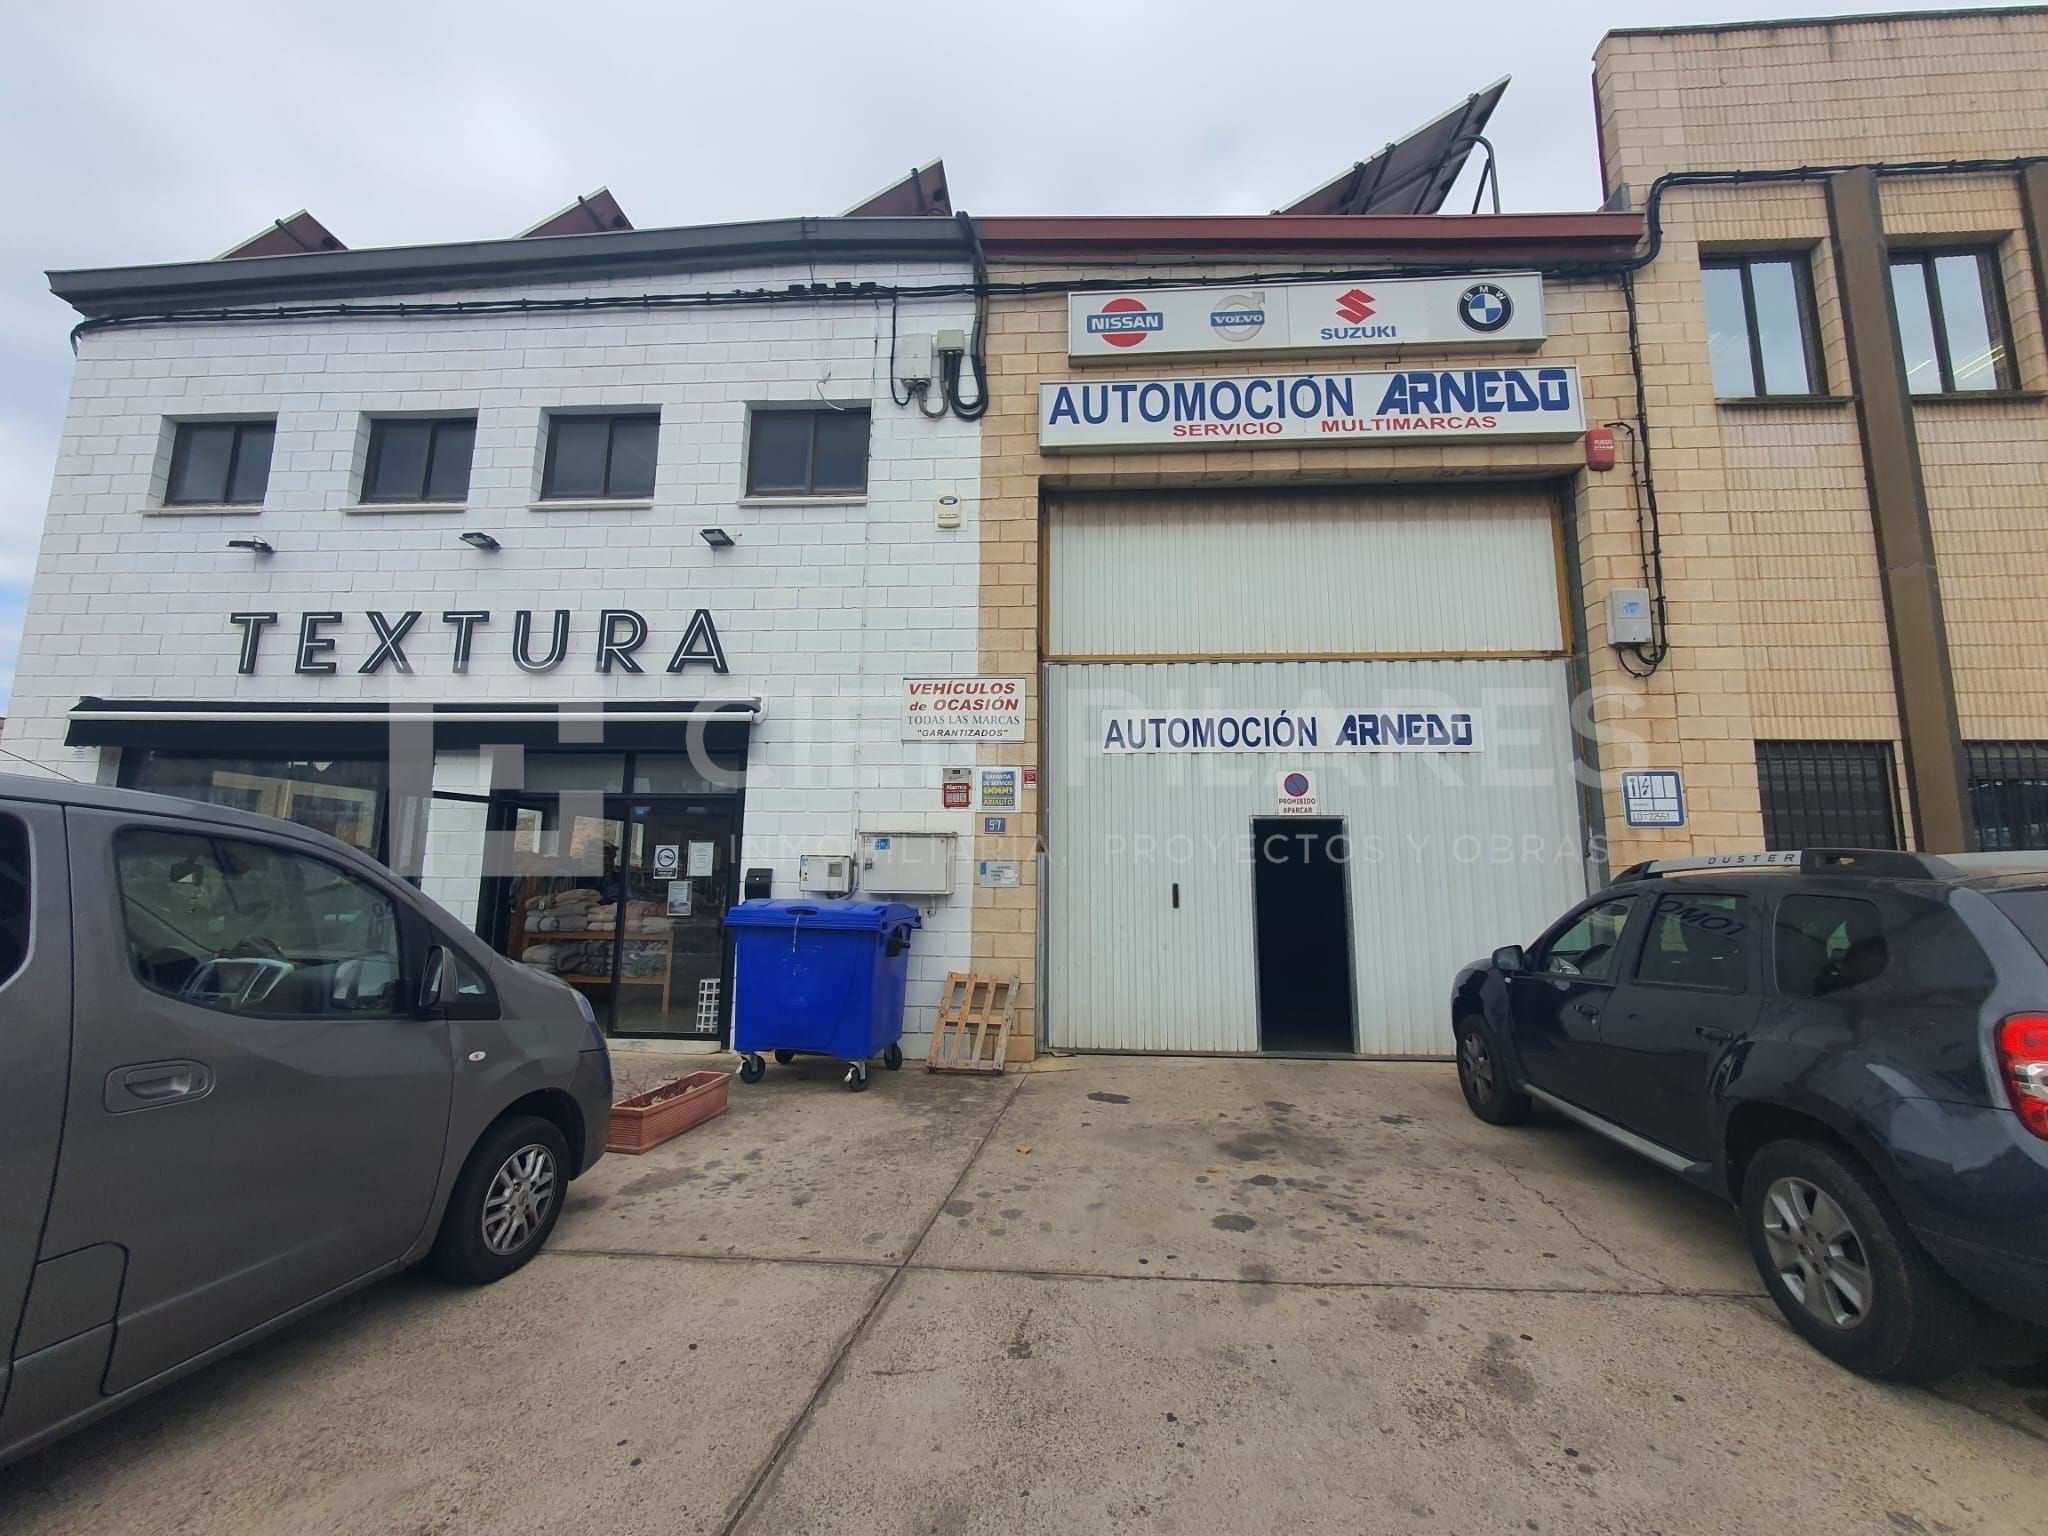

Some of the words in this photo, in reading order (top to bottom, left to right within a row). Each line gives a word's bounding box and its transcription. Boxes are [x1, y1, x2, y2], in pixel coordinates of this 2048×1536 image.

[1463, 285, 1507, 301] BMW
[1091, 315, 1159, 331] NISSAN
[1212, 314, 1264, 325] VOLVO
[1320, 325, 1397, 340] SUZUKI
[1048, 375, 1354, 425] AUTOMOCIÓN
[1375, 369, 1571, 415] ARNEDO
[1172, 421, 1284, 437] SERVICIO
[1320, 415, 1498, 433] MULTIMARCAS
[229, 608, 730, 675] TEXTURA
[909, 680, 1016, 695] VEHÍCULOS
[909, 701, 927, 711] de
[933, 696, 1020, 711] OCASIÓN
[907, 715, 946, 725] TODAS
[948, 715, 969, 725] LAS
[972, 714, 1021, 725] MARCAS
[1103, 709, 1319, 749] AUTOMOCIÓN
[1335, 714, 1473, 746] ARNEDO
[989, 819, 1002, 830] 57
[1707, 853, 1796, 865] DUSTER
